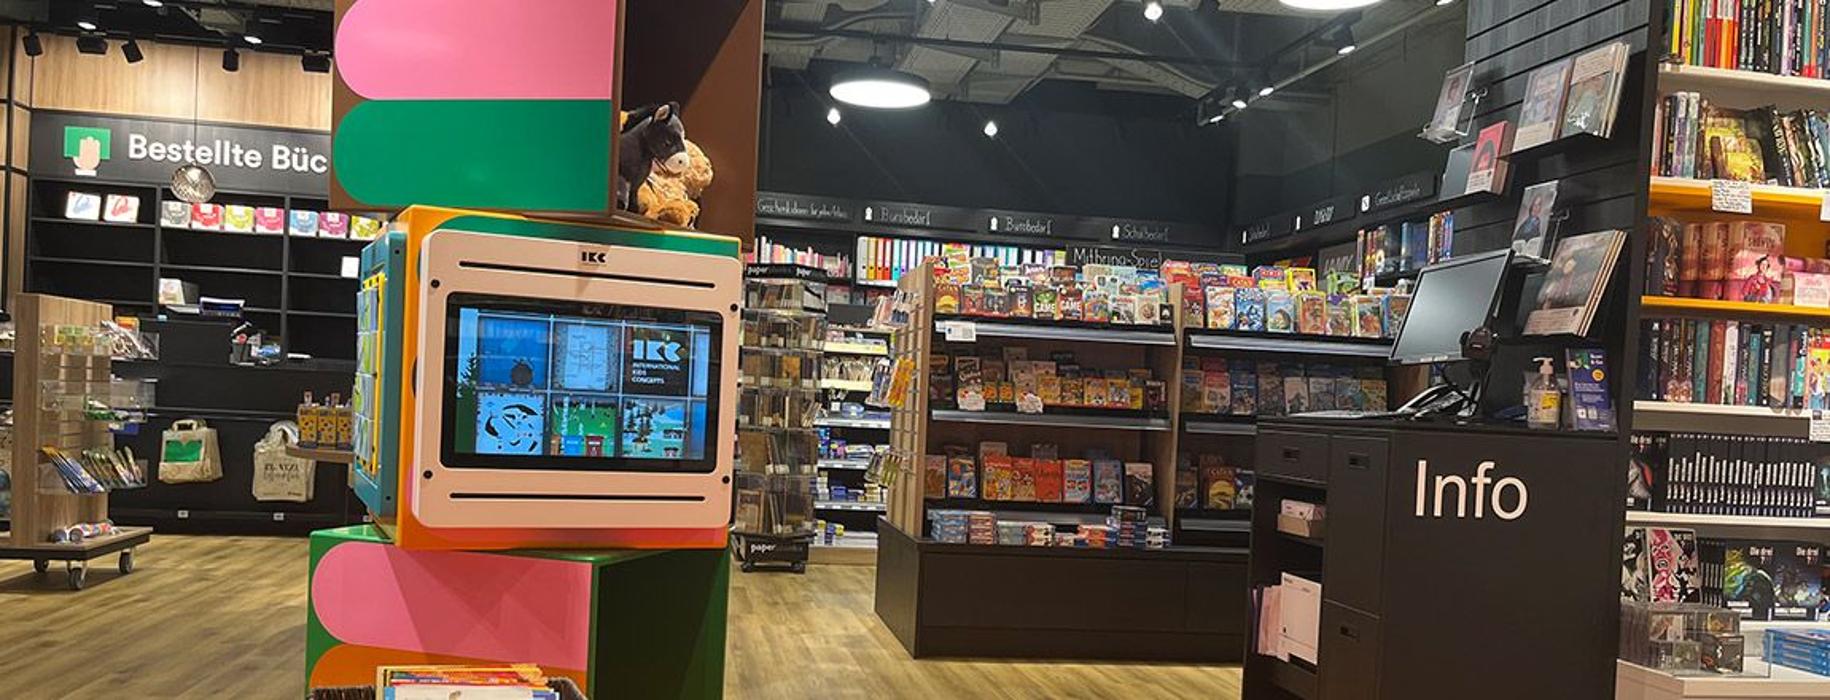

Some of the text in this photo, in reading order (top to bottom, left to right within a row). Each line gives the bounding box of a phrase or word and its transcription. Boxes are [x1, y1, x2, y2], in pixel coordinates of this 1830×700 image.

[128, 133, 263, 168] Bestellte
[581, 252, 606, 263] IKC
[633, 339, 681, 362] IKC
[1415, 460, 1529, 520] Info
